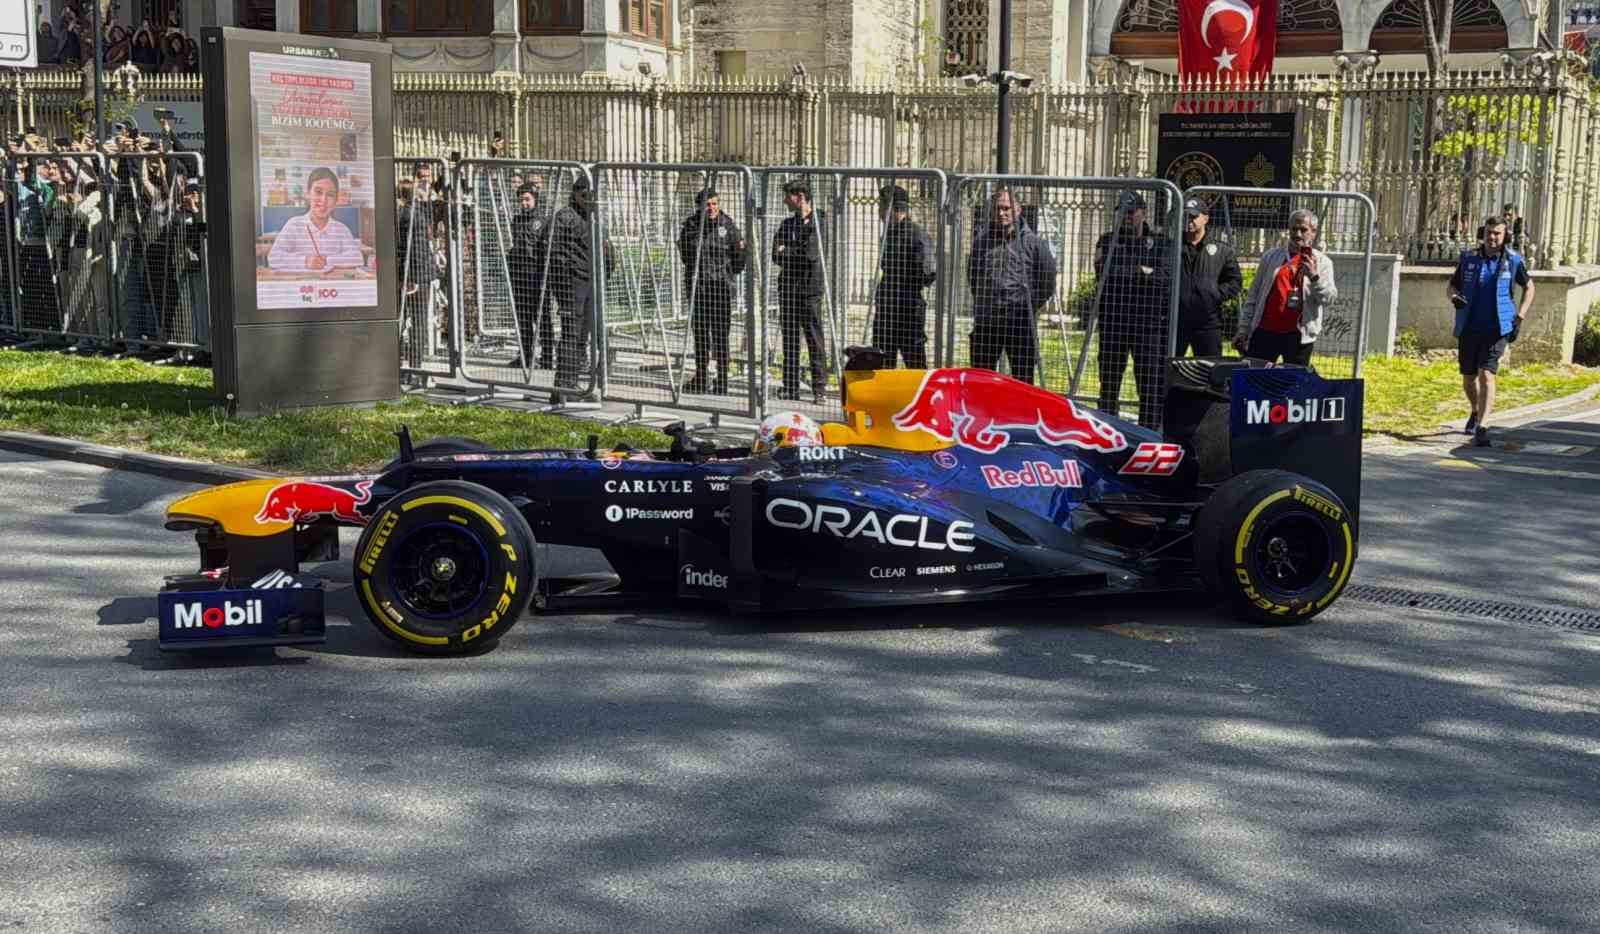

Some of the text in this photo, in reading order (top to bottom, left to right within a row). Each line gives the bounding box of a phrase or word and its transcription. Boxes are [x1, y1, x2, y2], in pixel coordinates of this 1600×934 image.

[10, 44, 23, 53] m
[1246, 397, 1317, 425] Mobil
[799, 446, 849, 461] ROKT
[1117, 442, 1185, 476] 22
[604, 480, 693, 493] CARLYLE
[625, 507, 694, 519] 1Password
[1293, 484, 1343, 522] PIRELLI
[765, 498, 976, 553] ORACLE
[359, 509, 400, 575] PIRELLI
[916, 565, 956, 575] SIEMENS
[462, 543, 518, 641] P ZERO
[174, 599, 262, 628] Mobil
